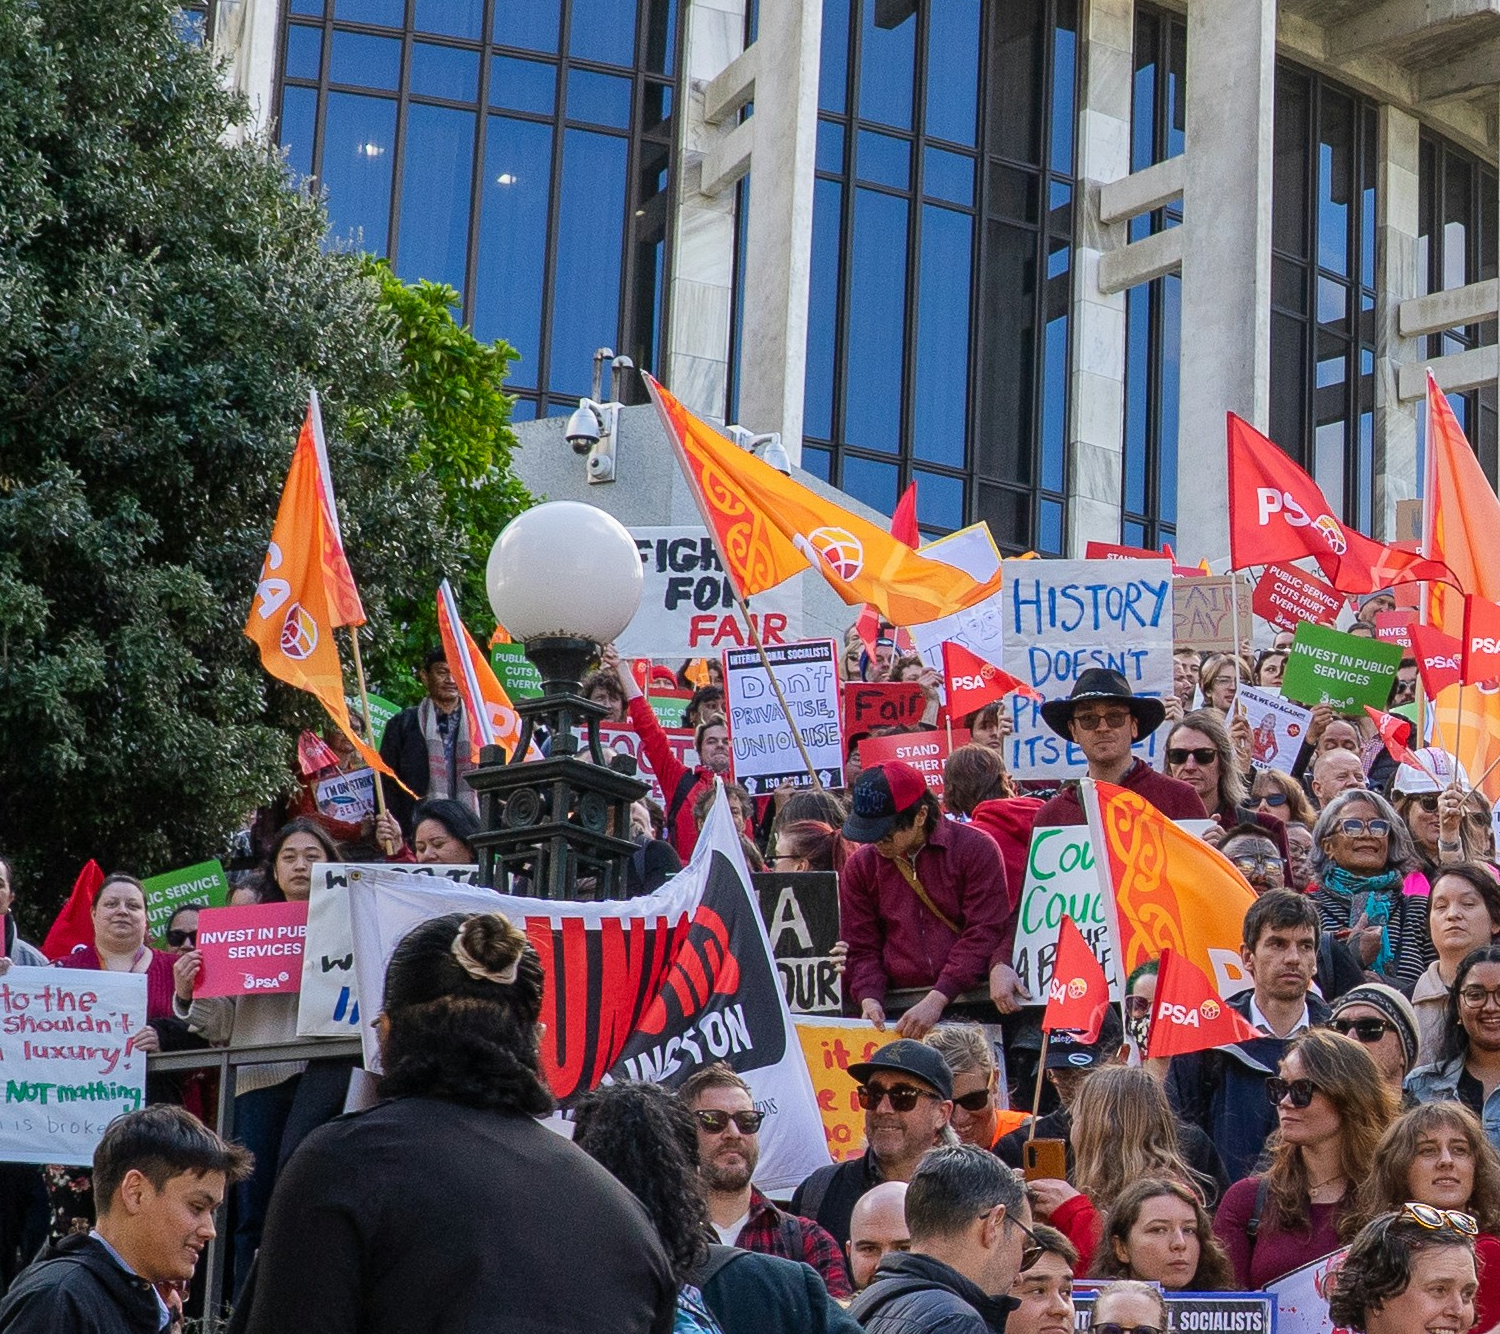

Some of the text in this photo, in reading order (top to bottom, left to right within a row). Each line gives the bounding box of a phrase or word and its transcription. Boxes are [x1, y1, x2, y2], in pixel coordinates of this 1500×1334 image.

[1269, 566, 1339, 610] PUBLIC SERVICE
[1274, 582, 1326, 614] CUTS HURT
[1014, 579, 1169, 635] HISTORY
[1270, 594, 1318, 622] EVERYONE
[1173, 606, 1227, 638] PAY
[1379, 627, 1406, 636] INVES
[1294, 643, 1395, 675] INVEST IN PUBLIC
[1425, 657, 1454, 669] PSA
[952, 675, 985, 691] PSA
[1313, 664, 1369, 686] SERVICES
[855, 691, 922, 721] Fair
[896, 744, 939, 758] STAND
[166, 876, 220, 900] SERVICE
[201, 926, 306, 944] INVEST IN PUB
[228, 943, 301, 959] SERVICES
[256, 977, 279, 988] PSA
[34, 984, 97, 1012] the
[4, 1012, 134, 1035] shouldn't
[1158, 1001, 1200, 1027] PSA
[24, 1038, 134, 1075] luxury!
[6, 1083, 56, 1104] NOT
[15, 1116, 33, 1131] is
[47, 1114, 104, 1134] broke
[1181, 1312, 1262, 1330] SOCIALISTS
